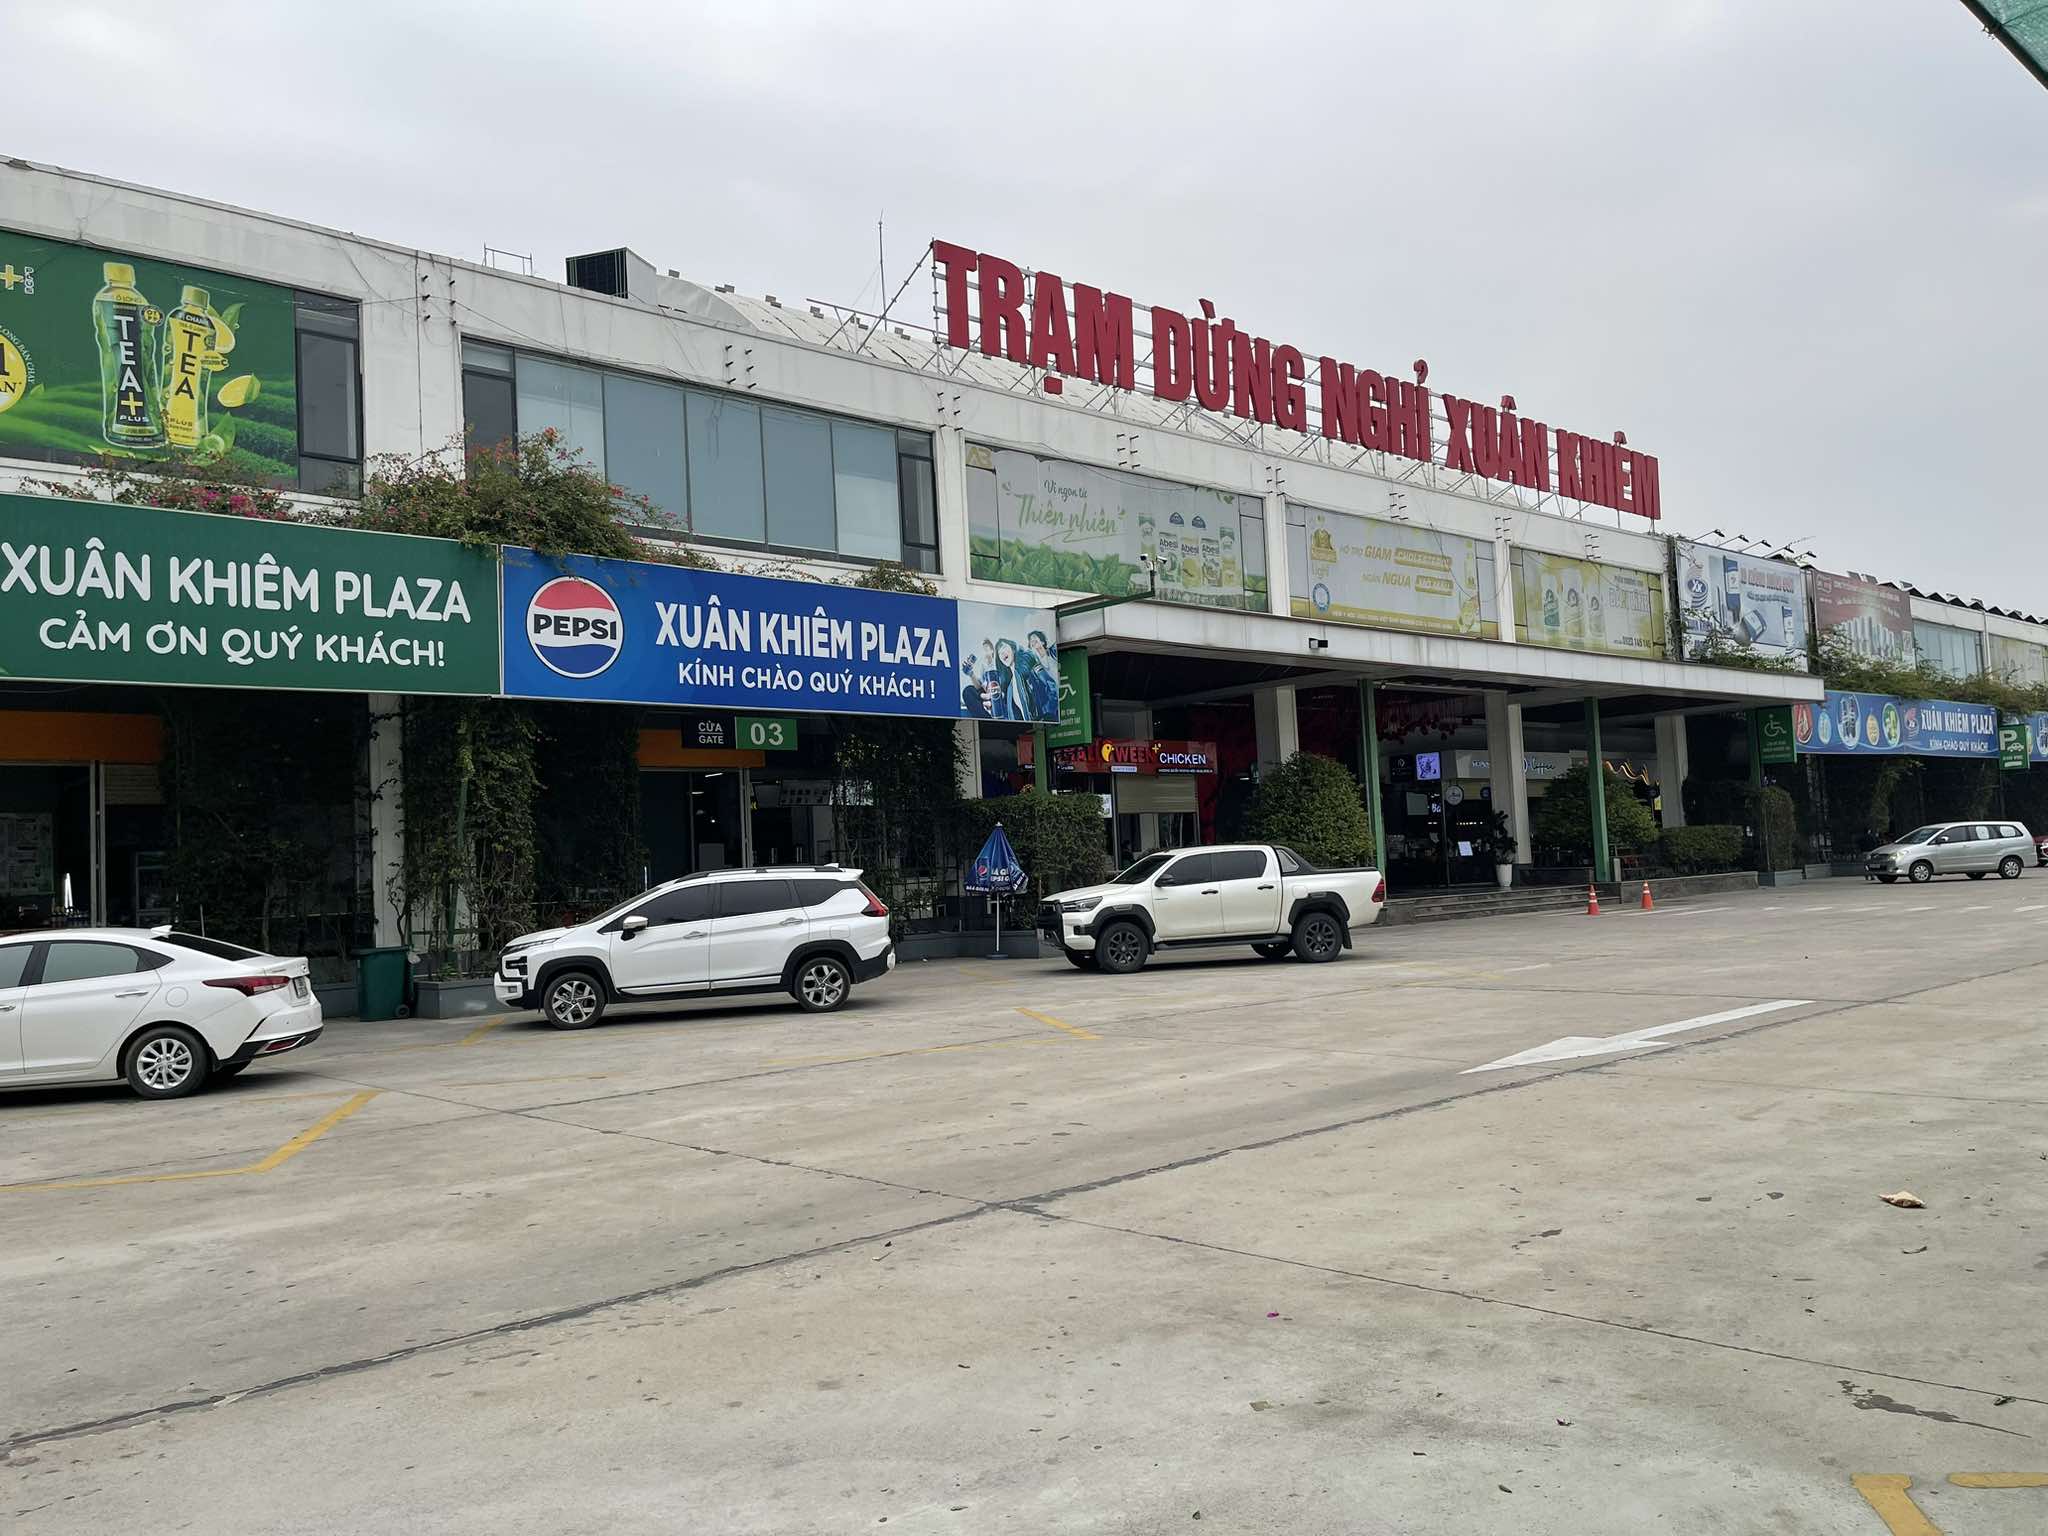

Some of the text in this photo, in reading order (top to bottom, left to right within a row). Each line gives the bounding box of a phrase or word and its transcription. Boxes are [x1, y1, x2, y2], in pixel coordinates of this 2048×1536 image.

[935, 241, 1661, 519] TRẠM DỪNG NGHỈ XUÂN KHIÊM
[1015, 493, 1065, 529] Thiên
[1, 537, 471, 625] XUÂN KHIÊM PLAZA
[39, 609, 446, 667] CẢM ƠN QUÝ KHÁCH!
[534, 613, 617, 640] PEPSI
[656, 595, 951, 667] XUÂN KHIÊM PLAZA
[679, 657, 734, 689] KÍNH
[741, 663, 803, 693] CHÀO
[809, 667, 853, 697] QUÝ
[860, 671, 925, 699] KHÁCH
[698, 720, 723, 732] CỬA
[750, 723, 784, 746] 03
[1920, 705, 1994, 735] XUÂN KHIÊM PLAZA
[698, 734, 724, 745] GATE
[2000, 730, 2017, 751] P
[1159, 752, 1206, 765] CHICKEN
